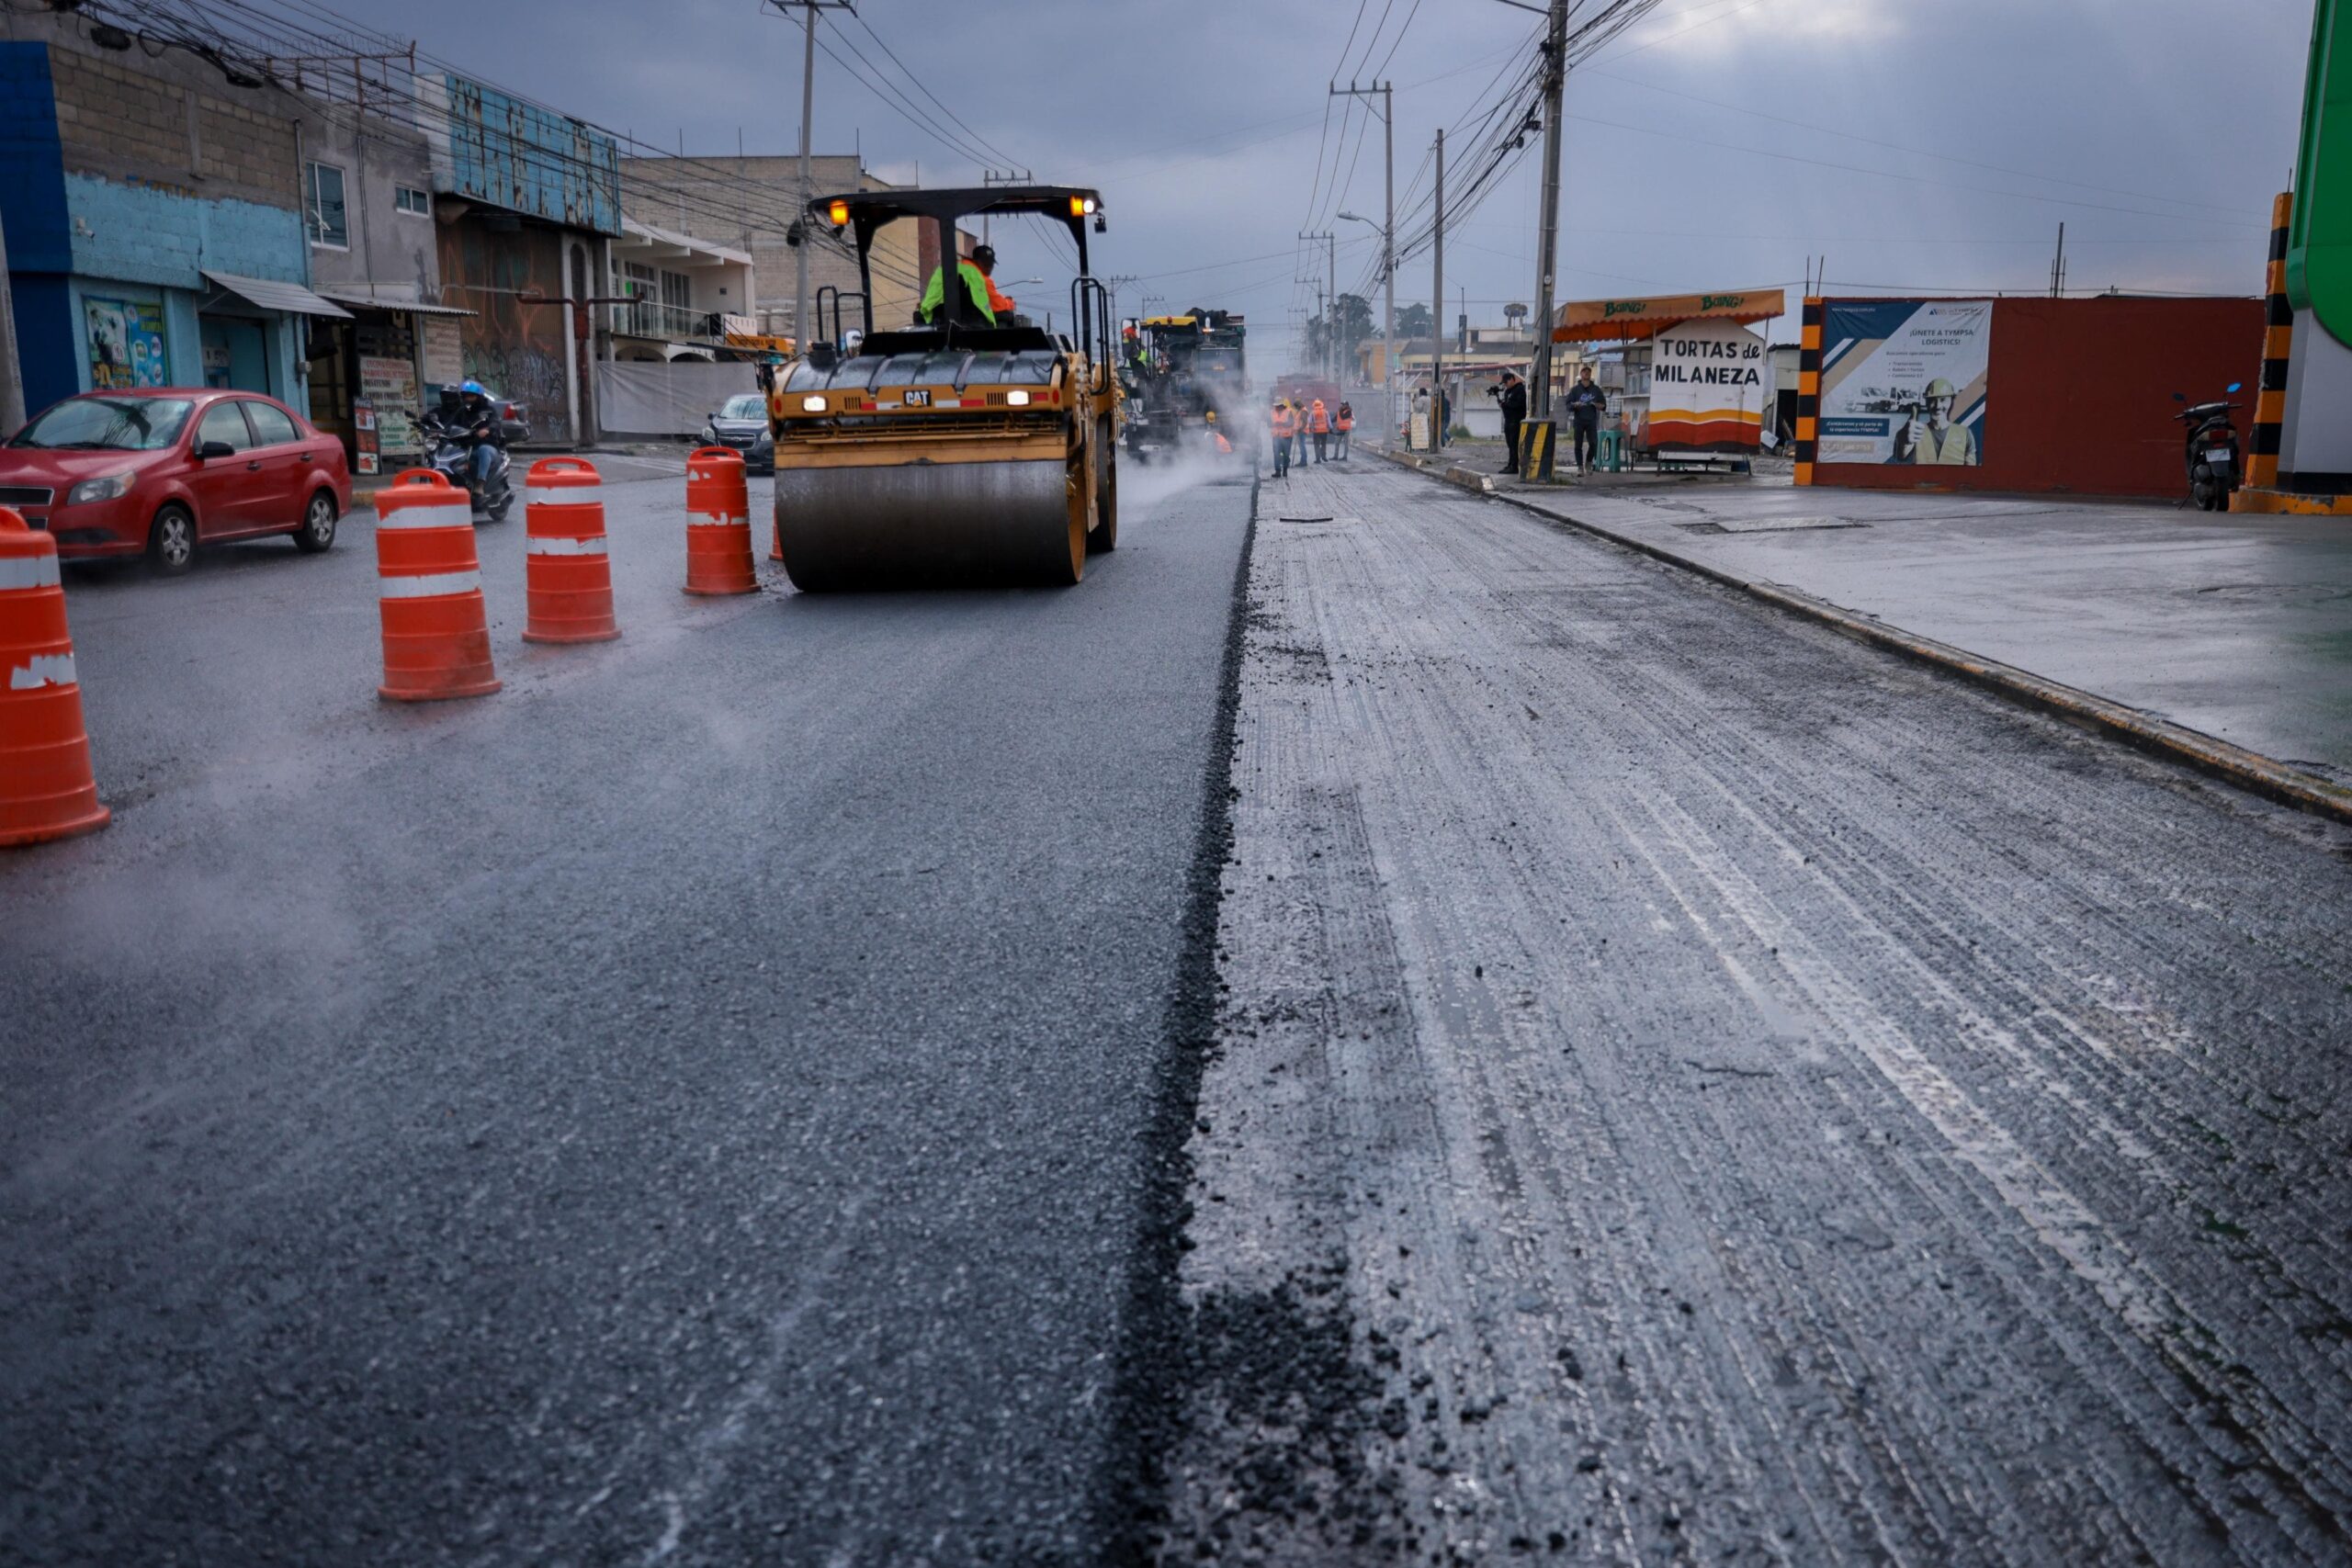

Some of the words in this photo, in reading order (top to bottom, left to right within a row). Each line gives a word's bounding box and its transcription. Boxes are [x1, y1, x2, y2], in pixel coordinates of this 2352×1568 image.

[1604, 300, 1646, 317] BOING!
[1702, 296, 1745, 311] BOING!
[1910, 328, 1936, 338] ¡ÚNETE
[1660, 339, 1737, 359] TORTAS
[1743, 343, 1760, 359] de
[1656, 365, 1760, 386] MILANEZA
[906, 390, 928, 406] CAT
